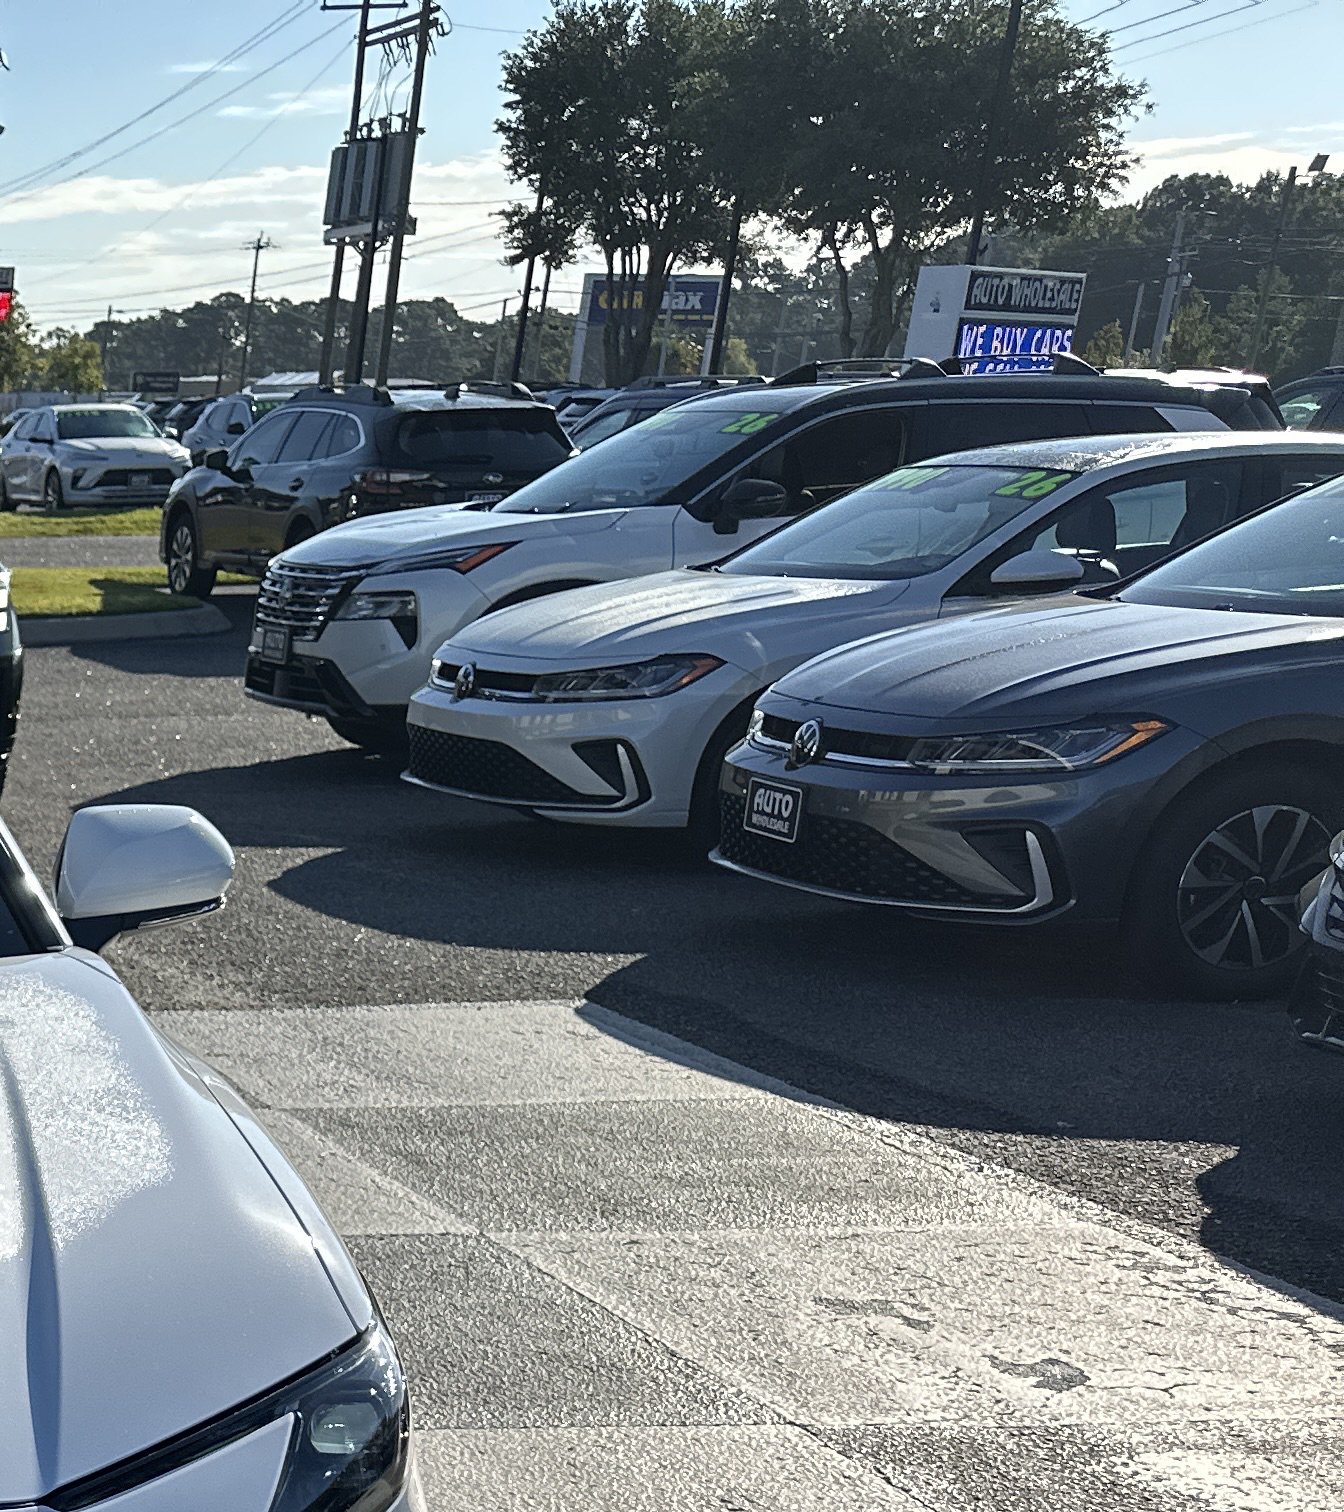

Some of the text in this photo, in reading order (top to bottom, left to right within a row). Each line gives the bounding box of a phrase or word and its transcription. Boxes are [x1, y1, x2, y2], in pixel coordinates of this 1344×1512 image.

[971, 276, 1081, 310] AUTO WHOLESALE
[960, 323, 1073, 358] WE BUY CARS
[719, 413, 779, 433] 26
[994, 471, 1072, 497] 26
[754, 788, 793, 818] AUTO
[751, 812, 790, 834] WHOLESALE
